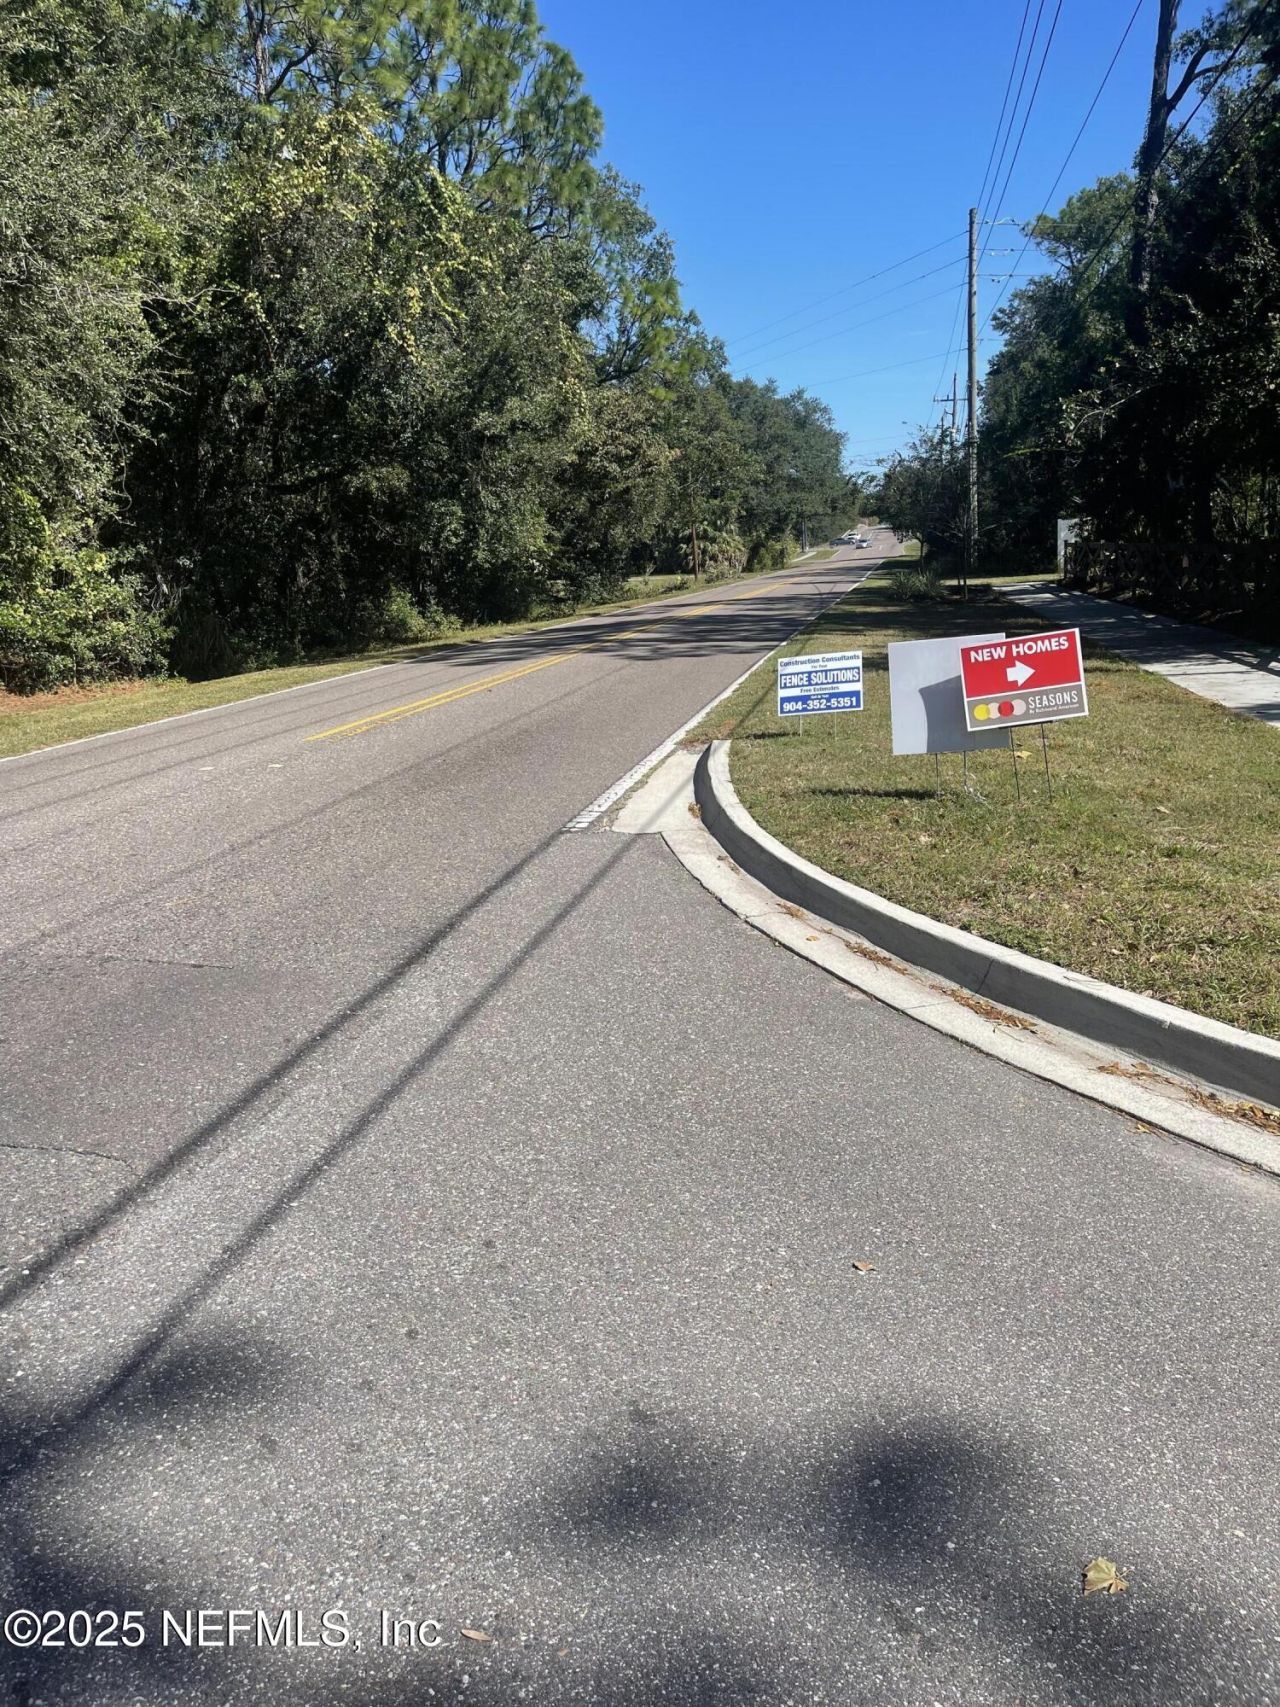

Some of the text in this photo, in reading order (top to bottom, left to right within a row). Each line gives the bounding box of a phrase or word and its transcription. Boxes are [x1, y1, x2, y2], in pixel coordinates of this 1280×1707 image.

[970, 637, 1069, 663] NEW HOMES
[780, 654, 860, 667] Construction Consultants
[781, 668, 859, 688] FENCE SOLUTIONS
[813, 685, 840, 693] Estimates
[783, 697, 857, 712] 904-352-5351
[1028, 690, 1079, 709] SEASONS
